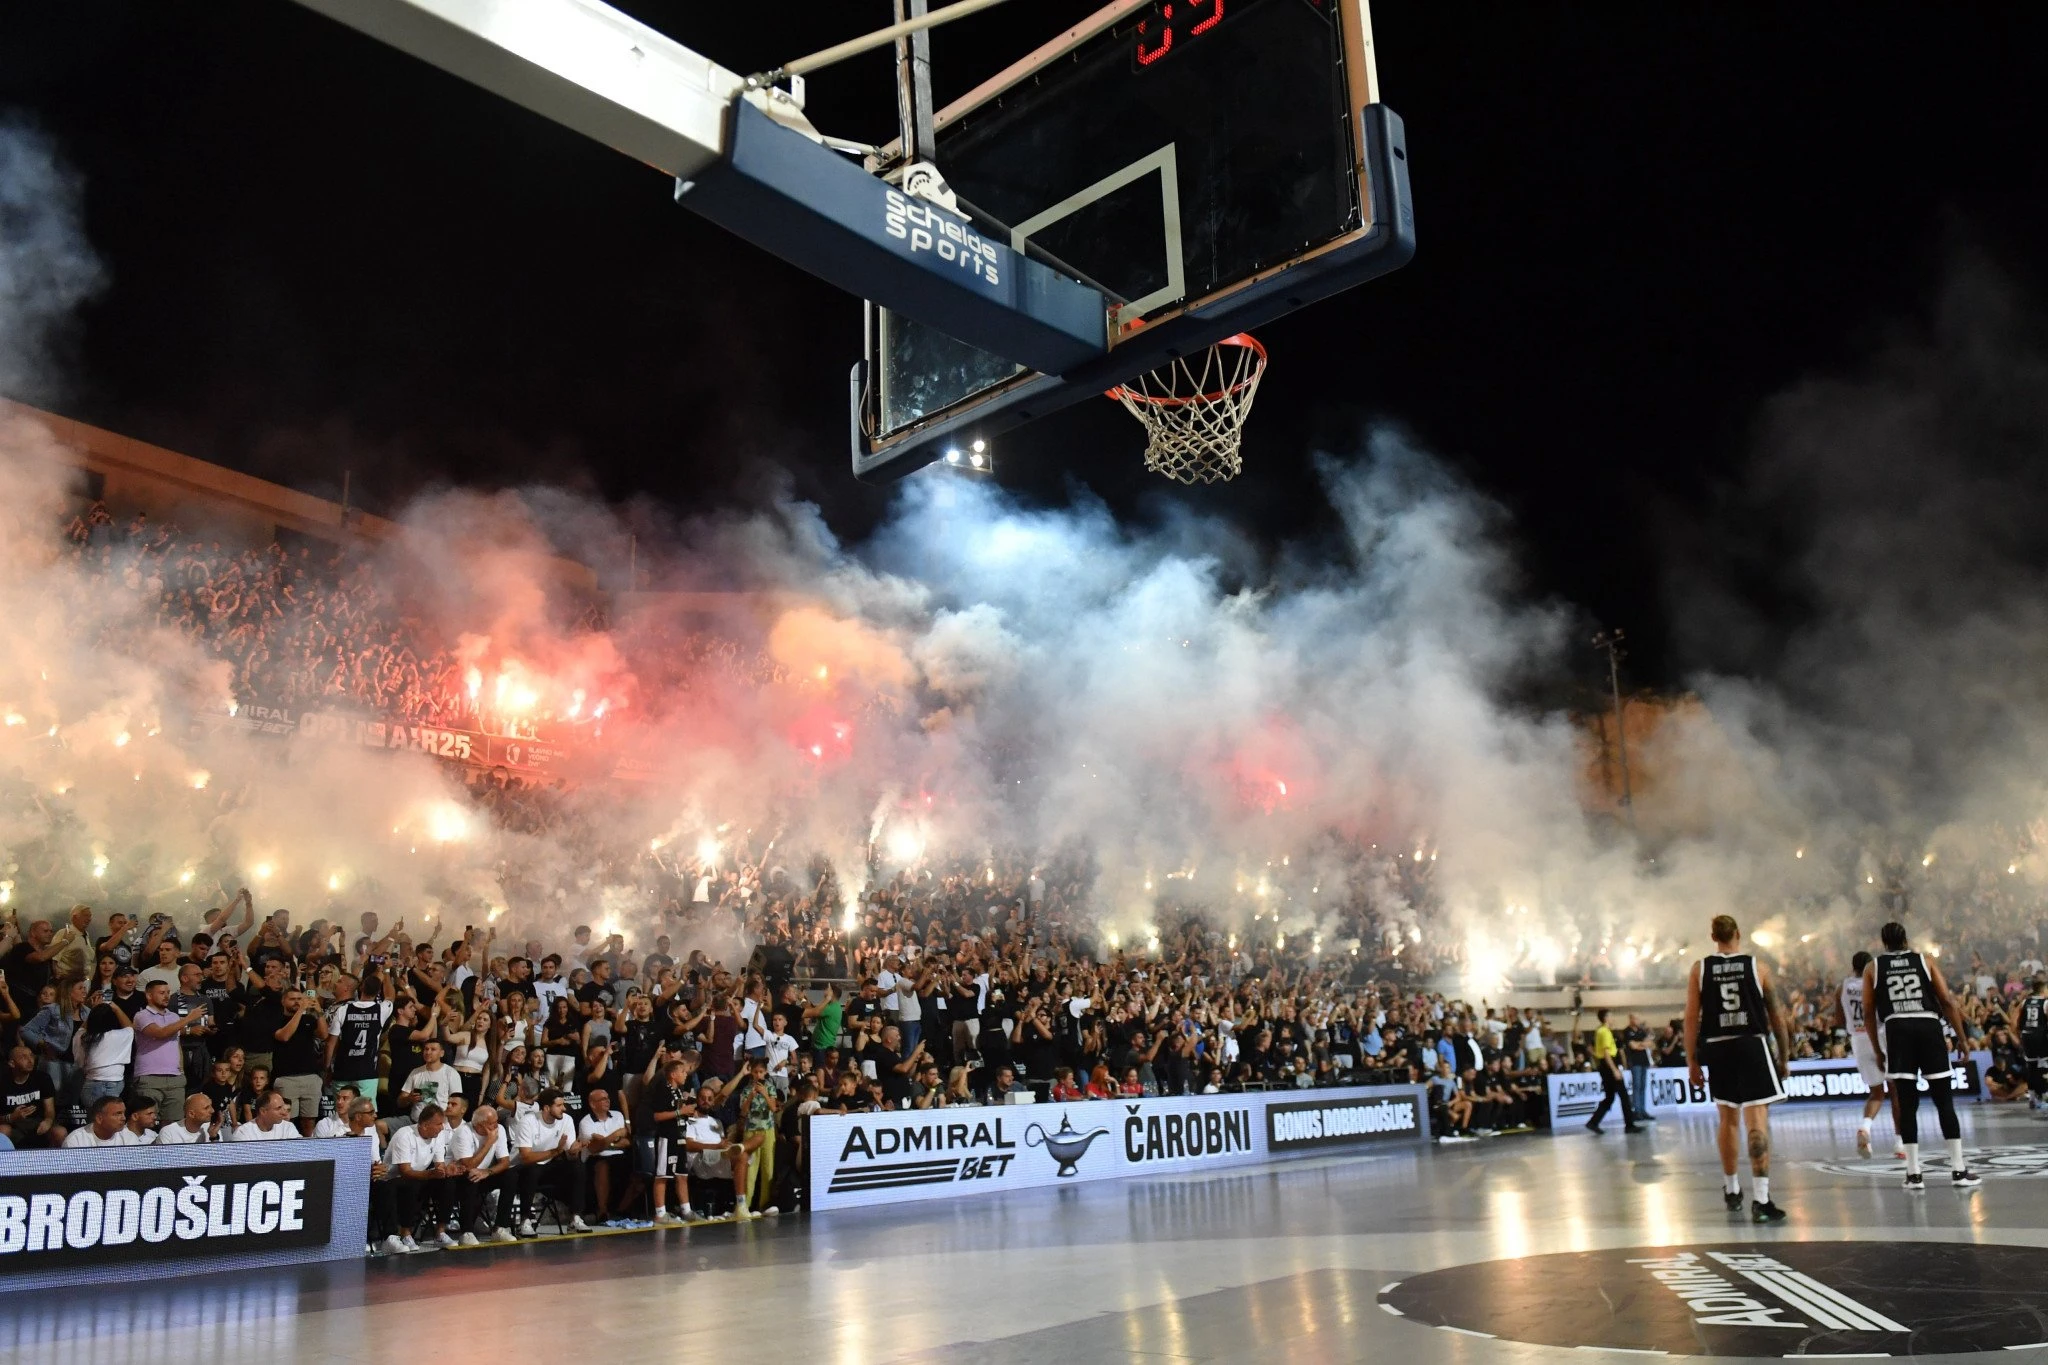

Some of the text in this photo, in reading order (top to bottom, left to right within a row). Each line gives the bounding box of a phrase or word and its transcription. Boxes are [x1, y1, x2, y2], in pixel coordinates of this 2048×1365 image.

[886, 189, 998, 265] Schelde
[885, 211, 999, 286] Sports
[1720, 982, 1740, 1011] 5
[1886, 974, 1923, 1000] 22
[354, 1021, 370, 1029] mts
[354, 1029, 368, 1049] 4
[839, 1117, 1016, 1162] ADMIRAL
[1125, 1105, 1251, 1162] ČAROBNI
[1274, 1100, 1415, 1142] BONUS DOBRODOŠLICE
[959, 1153, 1016, 1181] BET
[1625, 1252, 1808, 1328] ADMIRAL
